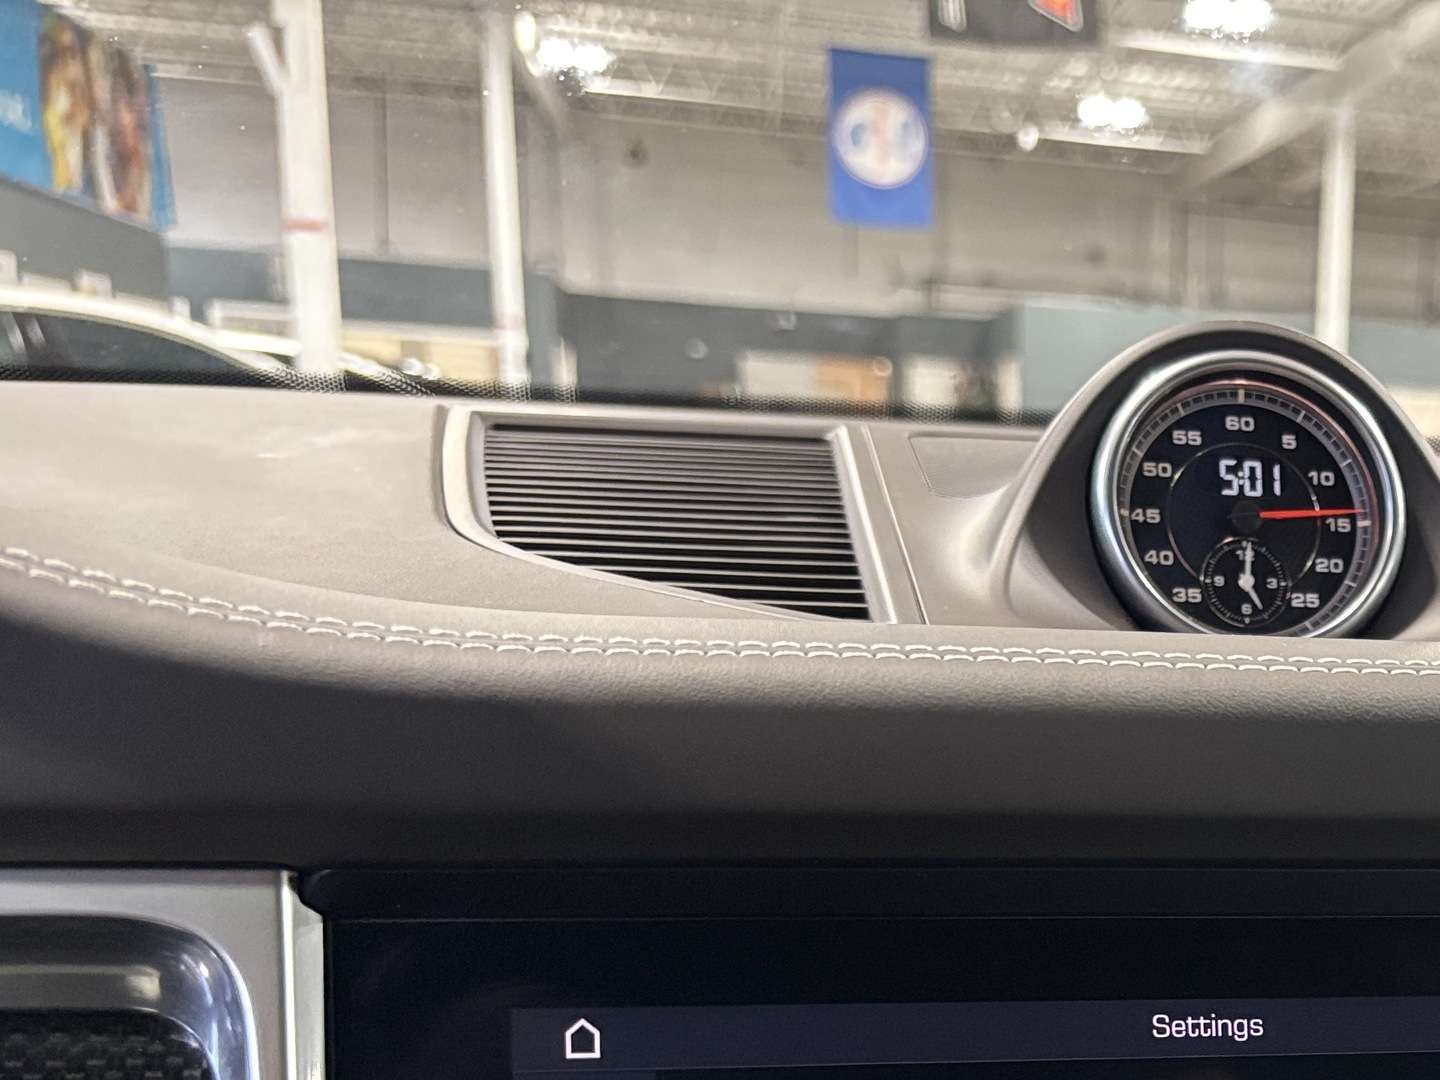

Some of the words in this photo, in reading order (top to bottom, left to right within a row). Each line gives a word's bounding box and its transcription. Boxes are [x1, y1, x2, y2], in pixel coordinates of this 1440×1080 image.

[1226, 416, 1254, 431] 60
[1173, 431, 1201, 445] 55
[1282, 435, 1296, 449] 5
[1143, 462, 1171, 477] 50
[1219, 459, 1280, 497] 5:01
[1308, 471, 1334, 486] 10
[1131, 509, 1160, 524] 45
[1326, 518, 1350, 532] 15
[1145, 550, 1173, 565] 40
[1316, 558, 1343, 573] 20
[1214, 576, 1224, 586] 9
[1267, 578, 1277, 588] 3
[1173, 588, 1201, 602] 35
[1290, 592, 1319, 607] 25
[1242, 604, 1252, 614] 6
[1153, 1014, 1263, 1041] Settings
